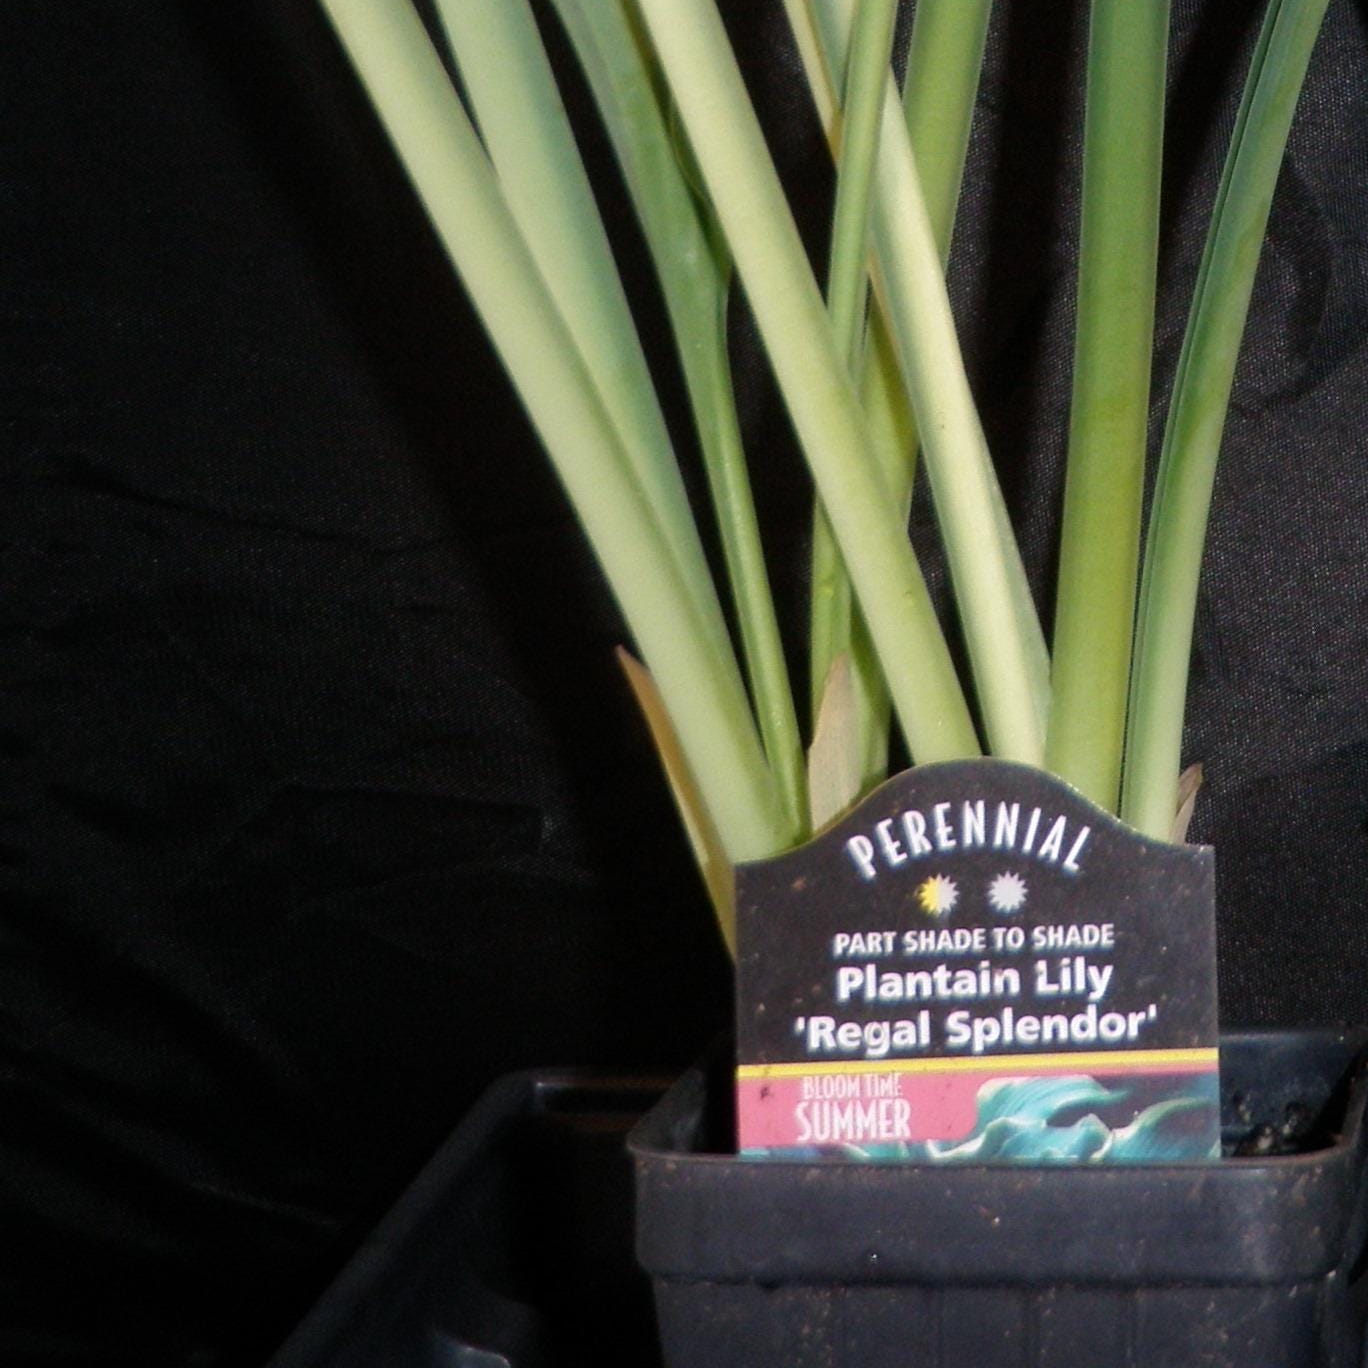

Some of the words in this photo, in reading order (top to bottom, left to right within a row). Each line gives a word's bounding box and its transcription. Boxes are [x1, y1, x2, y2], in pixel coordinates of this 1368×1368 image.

[847, 799, 1091, 880] PERENNIAL
[834, 931, 895, 955] PART
[905, 929, 985, 953] SHADE
[992, 927, 1024, 950] TO
[1033, 923, 1115, 948] SHADE
[837, 960, 1020, 1001] Plantain
[1037, 956, 1113, 999] Lily
[795, 1010, 930, 1055] 'Regal
[946, 1004, 1157, 1052] Splendor'
[803, 1075, 861, 1099] BLOOM
[864, 1072, 902, 1097] TIME
[795, 1098, 911, 1142] SUMMER
